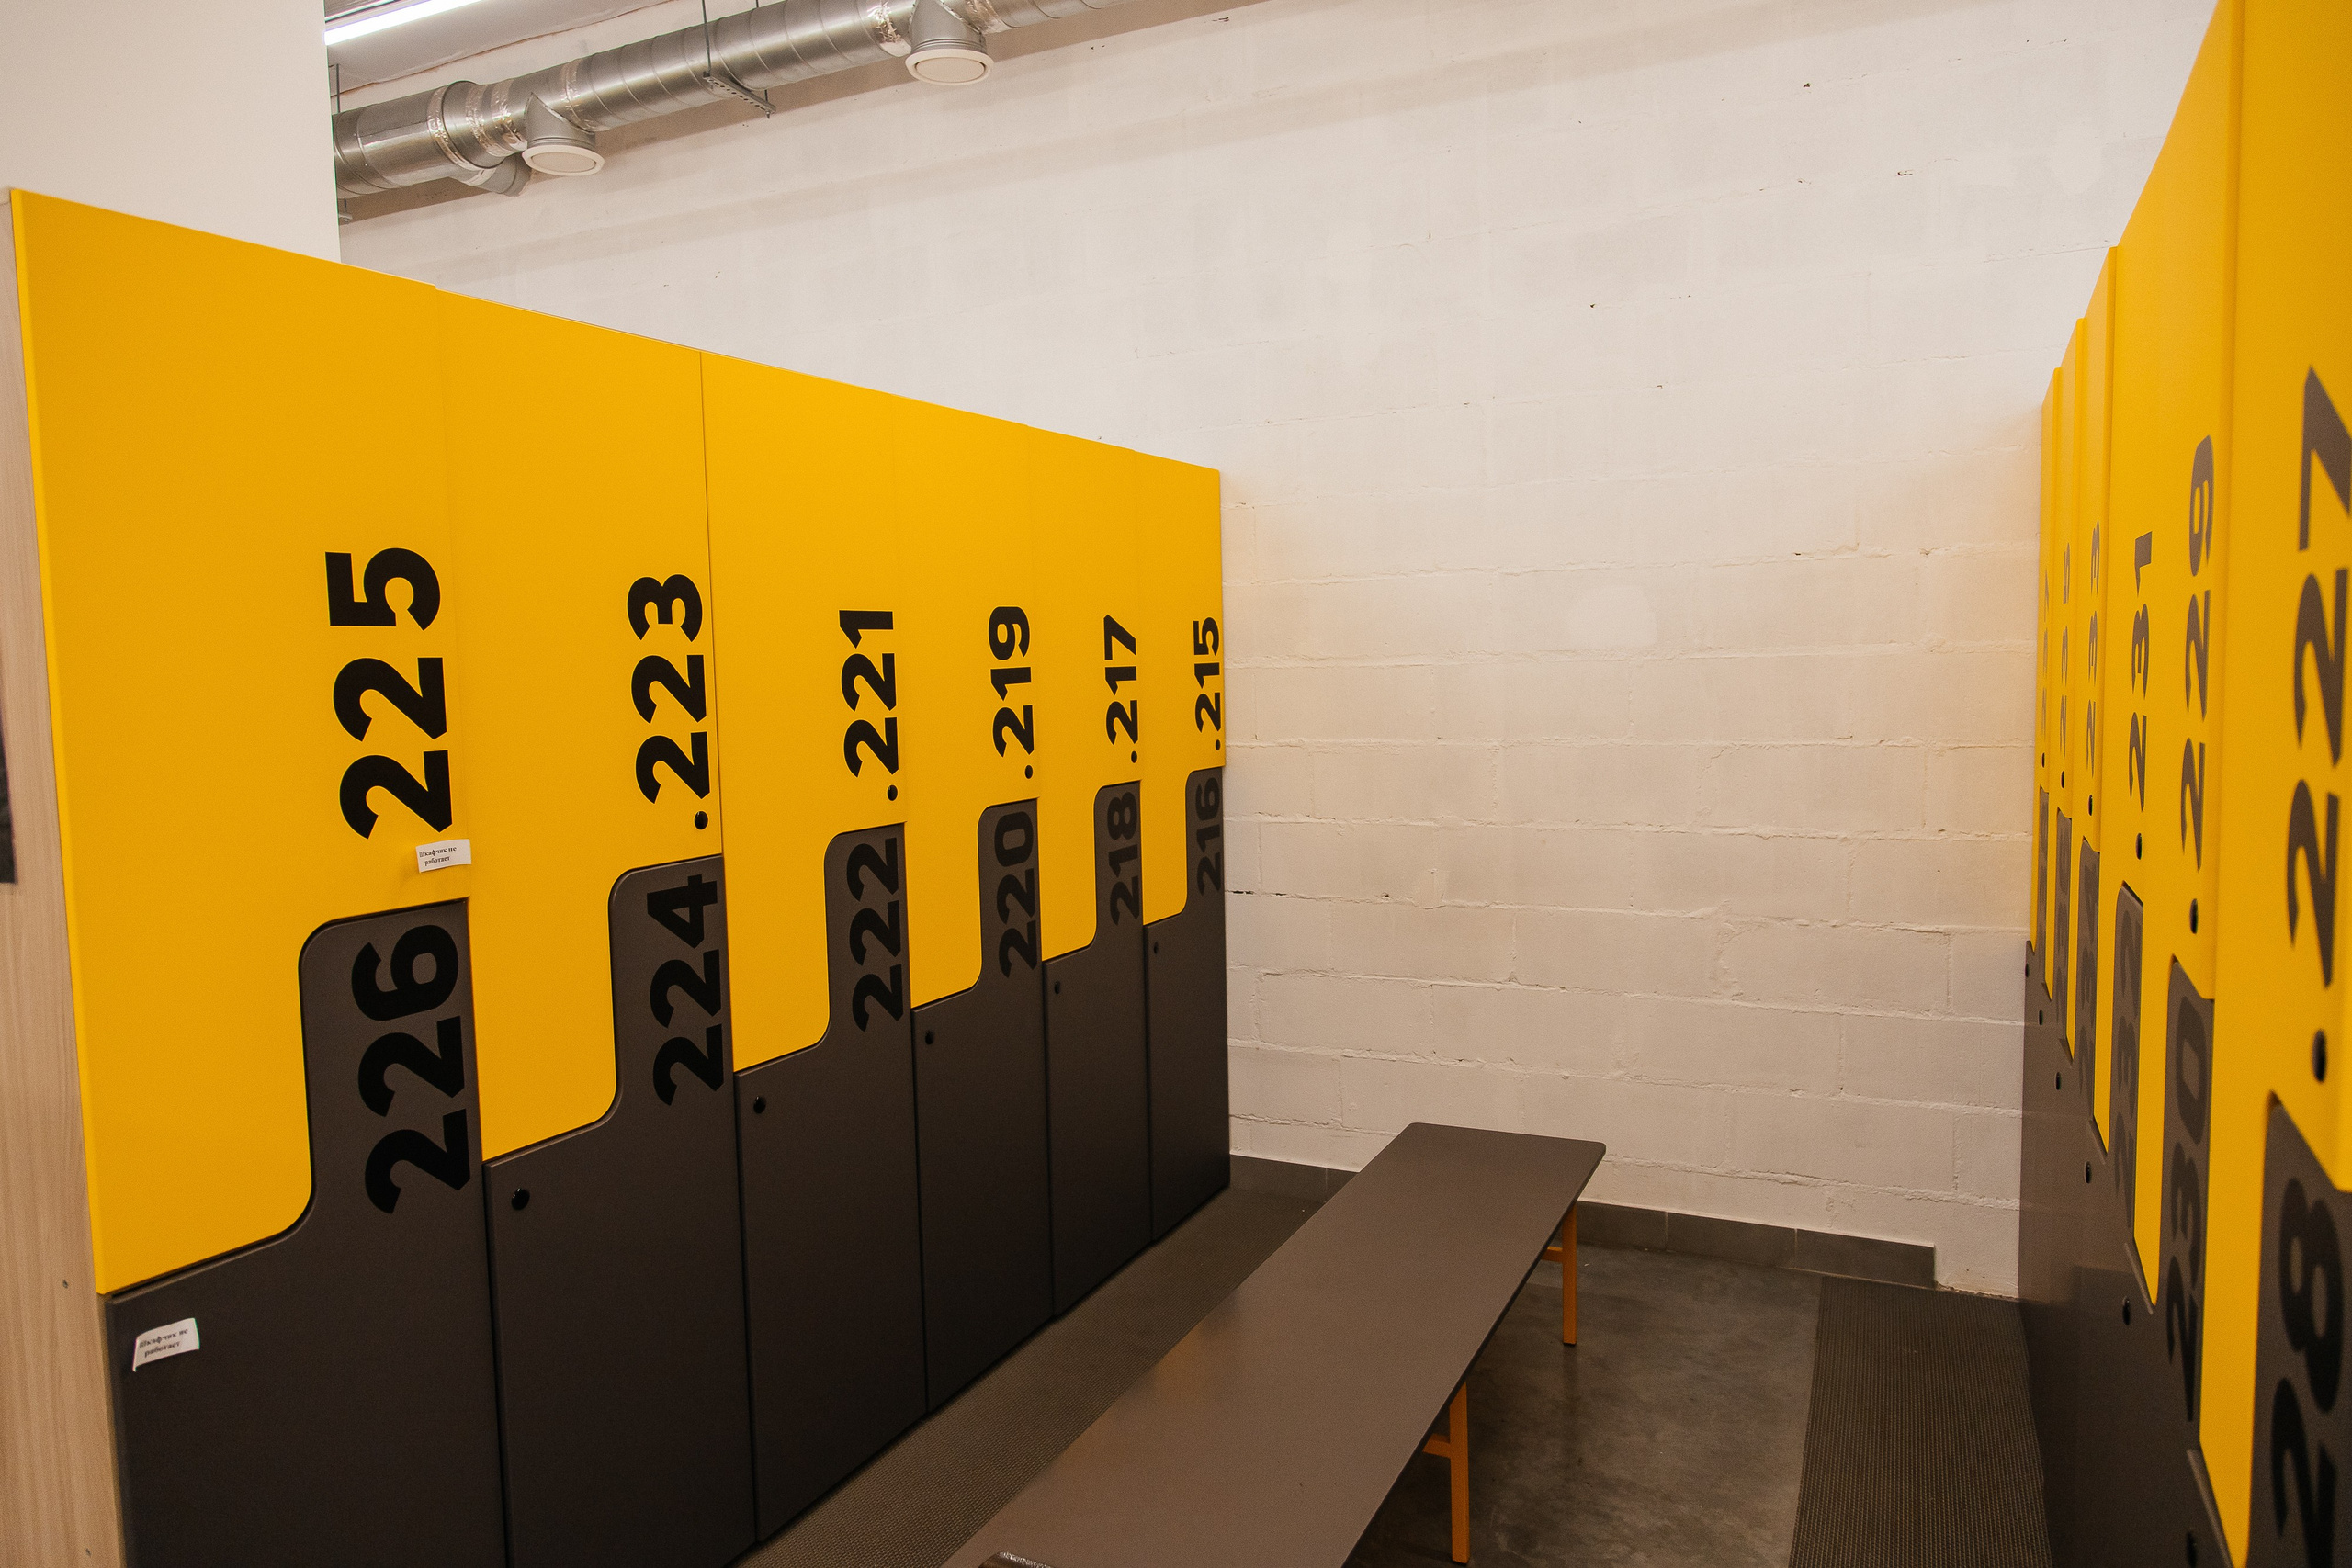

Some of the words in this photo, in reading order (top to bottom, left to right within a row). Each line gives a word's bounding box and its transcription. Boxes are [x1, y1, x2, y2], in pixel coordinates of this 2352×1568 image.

[325, 547, 453, 840] 225
[627, 573, 711, 805] 223
[839, 609, 899, 779] 221
[988, 606, 1035, 758] 219
[1103, 614, 1139, 746] 217
[1193, 616, 1222, 733] 215
[2086, 519, 2100, 779] 233
[2129, 530, 2153, 814] 231
[2180, 434, 2215, 873] 229
[2286, 364, 2352, 990] 227
[424, 856, 451, 866] работает
[846, 837, 904, 1032] 222
[993, 810, 1037, 979] 220
[1106, 791, 1141, 926] 218
[1196, 776, 1222, 897] 216
[351, 924, 471, 1215] 226
[647, 874, 724, 1107] 224
[2079, 864, 2099, 1117] 234
[2114, 910, 2143, 1228] 232
[2165, 995, 2206, 1423] 230
